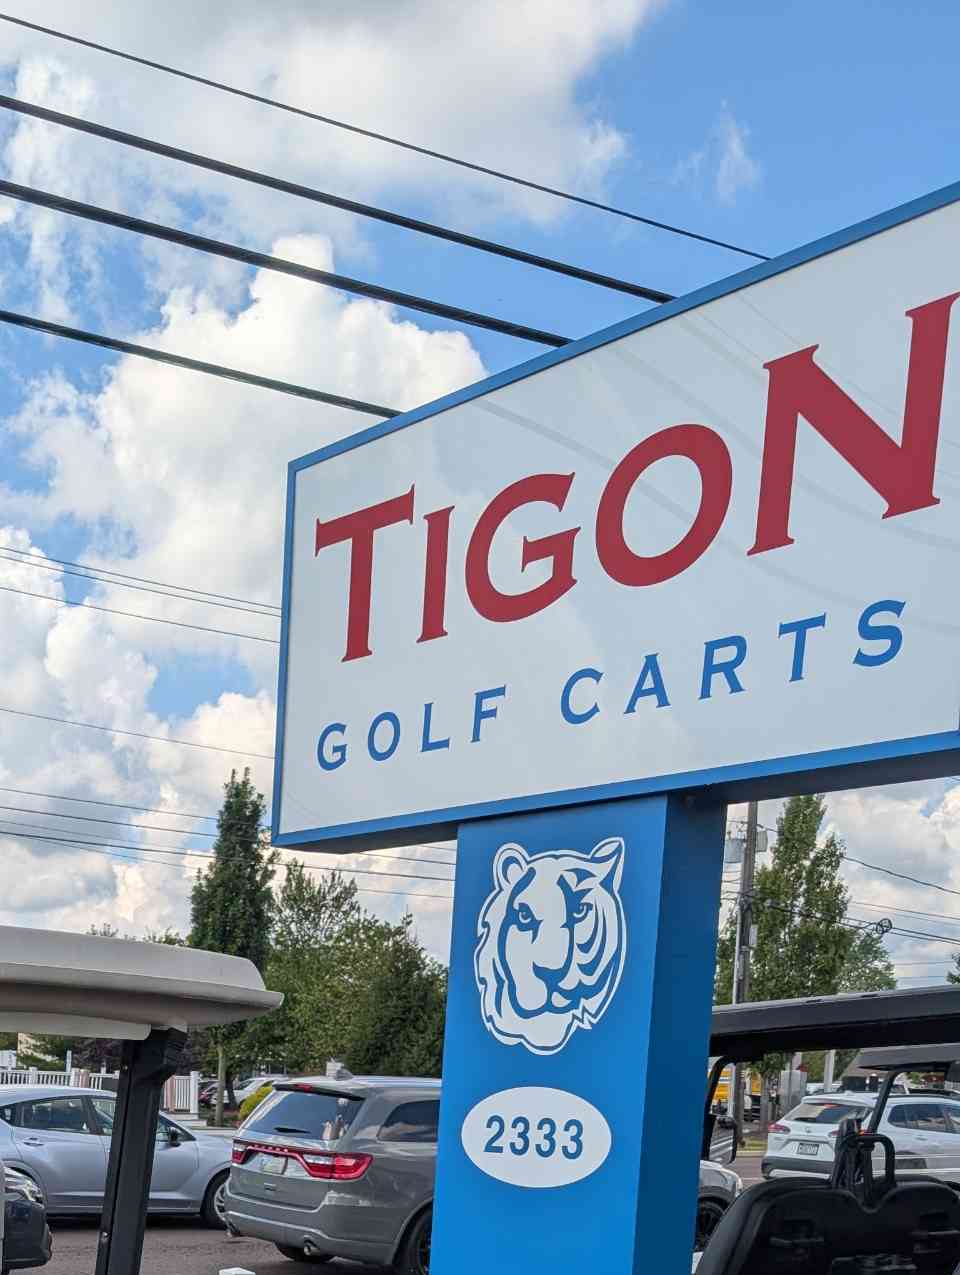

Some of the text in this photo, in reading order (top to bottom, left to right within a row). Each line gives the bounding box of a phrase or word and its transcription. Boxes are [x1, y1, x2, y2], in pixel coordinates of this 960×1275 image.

[315, 292, 960, 663] TIGON
[316, 600, 906, 771] GOLF CARTS
[483, 1114, 584, 1160] 2333
